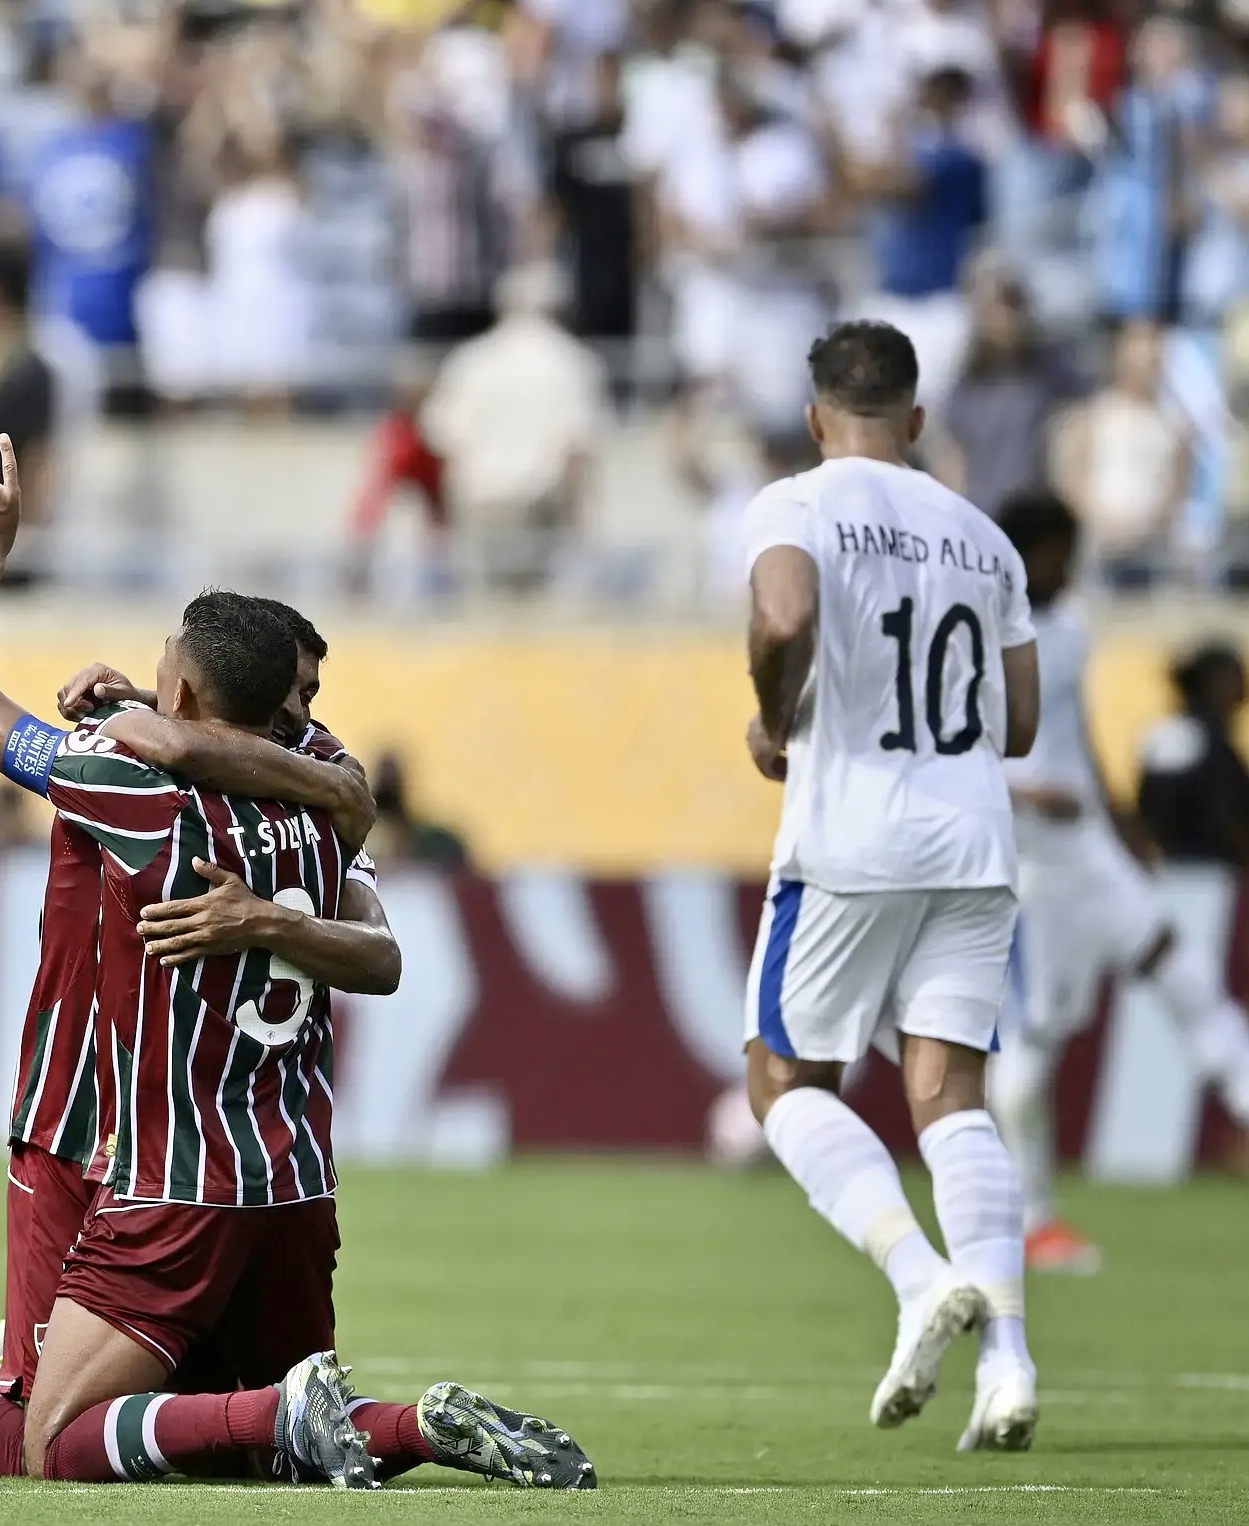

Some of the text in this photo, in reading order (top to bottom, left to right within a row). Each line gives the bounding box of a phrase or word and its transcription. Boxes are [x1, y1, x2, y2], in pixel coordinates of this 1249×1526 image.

[880, 596, 985, 756] 10
[12, 724, 38, 773] the World
[23, 730, 50, 776] UNITES
[34, 735, 59, 778] FOOTBALL
